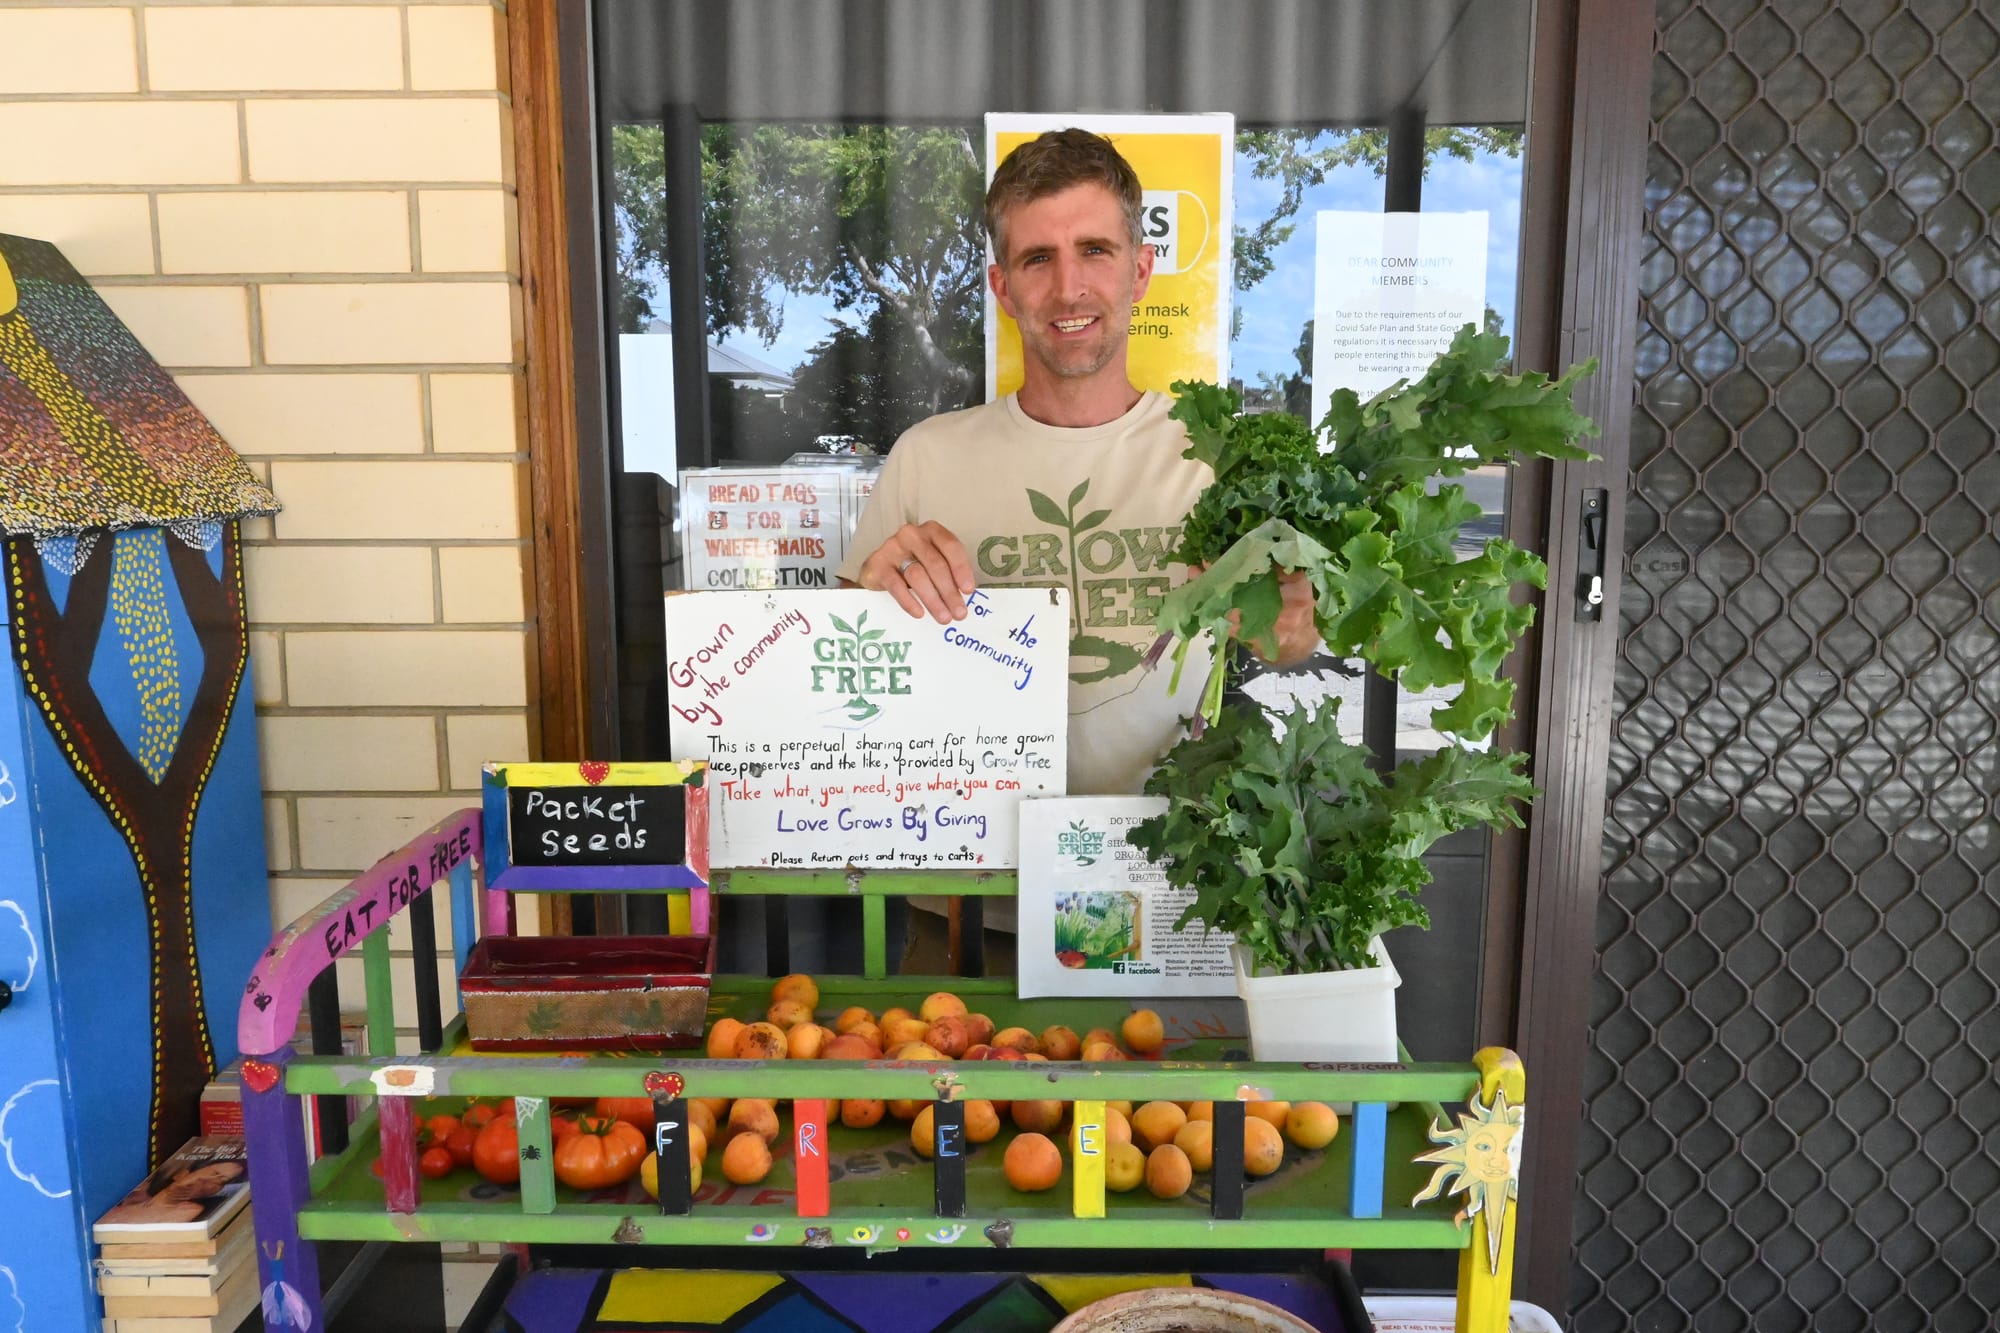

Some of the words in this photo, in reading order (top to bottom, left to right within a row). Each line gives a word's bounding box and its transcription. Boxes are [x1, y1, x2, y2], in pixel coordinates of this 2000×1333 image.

[1381, 257, 1453, 268] COMMUNITY
[1372, 276, 1428, 286] MEMBERS
[1146, 304, 1189, 317] mask
[1336, 311, 1352, 319] Due
[1354, 311, 1363, 319] to
[1364, 311, 1379, 319] the
[1380, 311, 1435, 320] requirements
[1438, 311, 1447, 319] of
[1128, 321, 1173, 338] ering.
[1336, 324, 1358, 332] Covid
[1360, 324, 1377, 332] Safe
[1380, 324, 1397, 332] Plan
[1399, 324, 1414, 332] and
[1417, 324, 1438, 332] State
[1333, 338, 1379, 346] regulations
[1397, 339, 1437, 347] necessary
[1334, 352, 1362, 360] people
[1364, 352, 1398, 360] entering
[1371, 365, 1403, 373] wearing
[708, 484, 760, 503] BREAD
[766, 483, 817, 504] TAGS
[747, 511, 782, 529] FOR
[977, 526, 1183, 577] GROW
[966, 590, 993, 618] For
[1009, 614, 1037, 648] the
[669, 623, 735, 688] Grown
[813, 637, 912, 663] GROW
[671, 700, 723, 727] by
[700, 674, 731, 699] the
[734, 608, 812, 676] community
[811, 665, 912, 694] FREE
[707, 735, 737, 753] This
[745, 743, 756, 753] is
[763, 743, 771, 753] a
[780, 732, 845, 761] perpetual
[856, 733, 903, 762] sharing
[909, 739, 936, 749] cart
[943, 732, 966, 754] for
[976, 725, 1008, 745] home
[1014, 733, 1055, 755] grown
[810, 754, 833, 770] and
[839, 753, 857, 769] the
[863, 752, 889, 770] like,
[898, 750, 953, 776] provided
[959, 749, 974, 774] by
[982, 751, 1018, 769] Grow
[1025, 752, 1051, 769] Free
[720, 779, 761, 800] Take
[774, 774, 810, 797] what
[819, 786, 844, 807] you
[853, 774, 891, 796] need,
[895, 781, 922, 802] give
[927, 773, 959, 790] what
[962, 779, 988, 801] you
[995, 779, 1021, 790] can
[526, 792, 645, 821] Packet
[777, 809, 829, 832] Love
[838, 807, 893, 831] Grows
[902, 806, 927, 841] By
[935, 805, 987, 839] Giving
[1110, 817, 1123, 825] DO
[542, 822, 648, 856] Seeds
[1058, 831, 1106, 844] GROW
[771, 852, 803, 866] Please
[811, 851, 843, 862] Return
[876, 848, 895, 861] and
[899, 852, 928, 867] trays
[934, 852, 944, 861] to
[948, 850, 975, 861] carts
[1057, 843, 1103, 855] FREE
[325, 900, 378, 958] EAT
[389, 865, 421, 914] FOR
[430, 827, 471, 880] FREE
[1128, 967, 1161, 975] facebook
[1303, 1062, 1406, 1073] Capsicum
